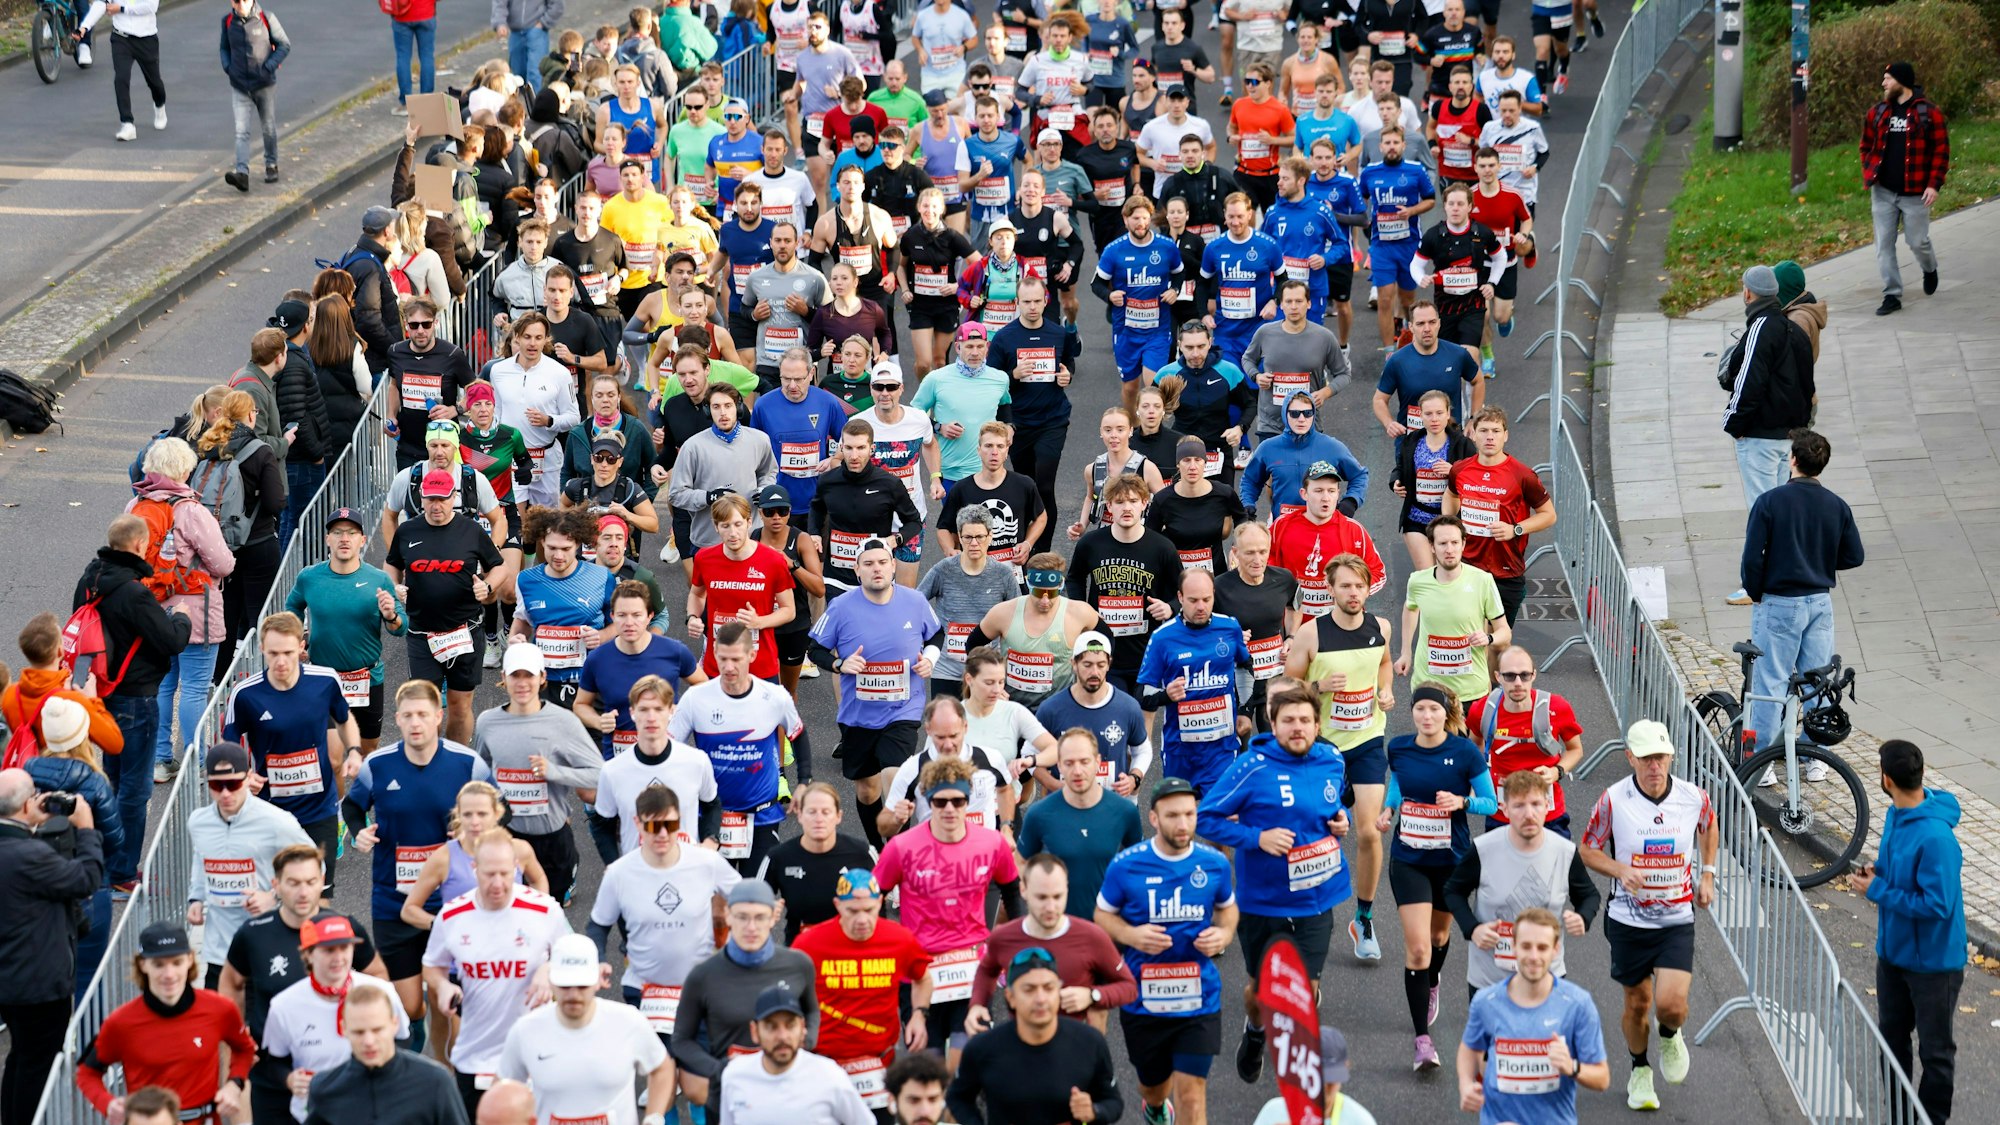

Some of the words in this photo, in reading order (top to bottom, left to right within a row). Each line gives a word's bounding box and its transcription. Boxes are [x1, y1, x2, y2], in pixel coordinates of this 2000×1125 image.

[1498, 154, 1518, 162] obias
[1379, 221, 1404, 231] Moritz
[1286, 271, 1305, 279] omas
[1224, 299, 1241, 308] Eike
[983, 311, 1013, 322] Sandra
[1126, 307, 1156, 318] Mattias
[773, 329, 799, 338] GENERALI
[1027, 350, 1055, 359] GENERALI
[411, 376, 441, 386] GENERALI
[1281, 374, 1310, 384] GENERALI
[794, 444, 818, 454] GENERALI
[874, 450, 910, 459] SAYSKY
[789, 456, 809, 466] Erik
[1463, 483, 1507, 496] RheinEnergie
[1469, 500, 1499, 511] GENERALI
[1461, 510, 1494, 522] Christian
[836, 545, 857, 557] Pau
[1179, 551, 1211, 562] GENERALI
[410, 559, 465, 574] GMS
[1100, 558, 1145, 570] SHEFFIELD
[1092, 565, 1155, 590] VARSITY
[709, 580, 766, 592] #JEMEINSAM
[1107, 598, 1143, 608] GENERALI
[546, 628, 583, 638] GENERALI
[434, 632, 464, 648] Torsten
[948, 638, 966, 647] Chri
[1249, 637, 1283, 653] GENERALI
[1436, 637, 1469, 648] GENERALI
[537, 641, 575, 652] Hendrik
[1017, 653, 1053, 666] GENERALI
[1430, 650, 1465, 662] Simon
[868, 664, 904, 675] GENERALI
[1008, 662, 1046, 678] Tobias
[859, 677, 896, 688] Julian
[1344, 687, 1374, 702] GENERALI
[1189, 699, 1226, 714] GENERALI
[1334, 704, 1369, 717] Pedro
[1182, 716, 1220, 729] Jonas
[280, 752, 316, 768] GENERALI
[274, 769, 308, 783] Noah
[503, 787, 541, 798] aurenz
[1279, 785, 1296, 807] 5
[1401, 819, 1444, 832] Vanessa
[1299, 839, 1339, 860] GENERALI
[213, 860, 253, 874] GENERALI
[1293, 856, 1332, 875] Albert
[1644, 856, 1684, 869] GENERALI
[397, 865, 420, 878] Bas
[207, 876, 250, 889] Marcel
[654, 920, 685, 930] CERTA
[462, 960, 528, 979] REWE
[821, 959, 858, 976] ALTER
[861, 958, 896, 975] MANN
[1154, 966, 1199, 979] GENERALI
[938, 969, 967, 982] Finn
[825, 977, 840, 989] ON
[842, 976, 861, 989] THE
[862, 976, 892, 988] TRACK
[1148, 983, 1188, 995] Franz
[1498, 1059, 1550, 1074] Florian
